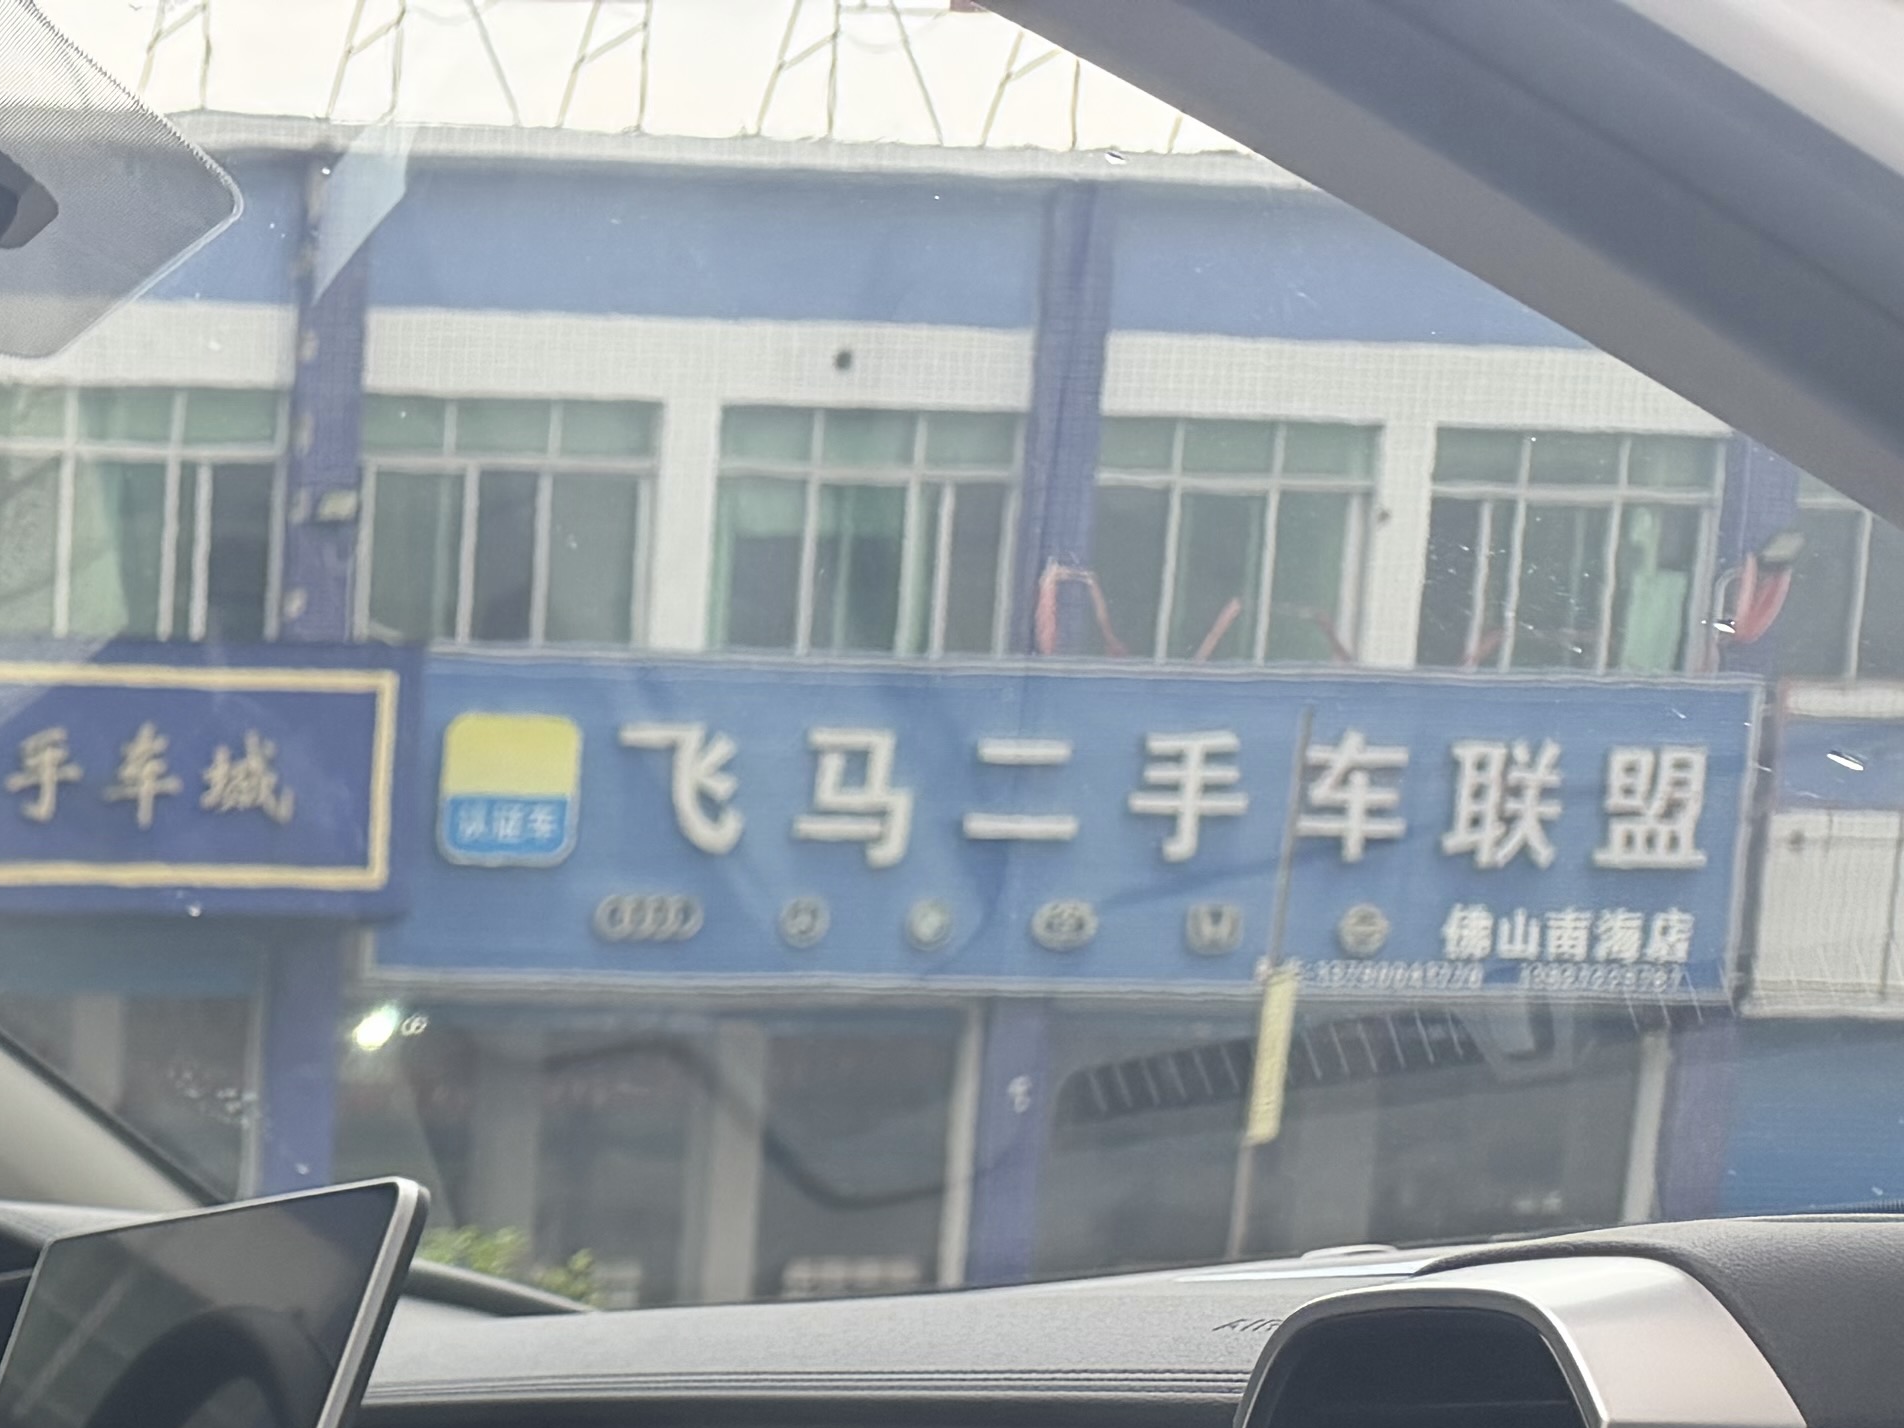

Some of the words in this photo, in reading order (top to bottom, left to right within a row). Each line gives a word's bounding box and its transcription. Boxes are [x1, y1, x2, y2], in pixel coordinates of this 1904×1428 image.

[618, 723, 1709, 871] 飞马二手车联盟
